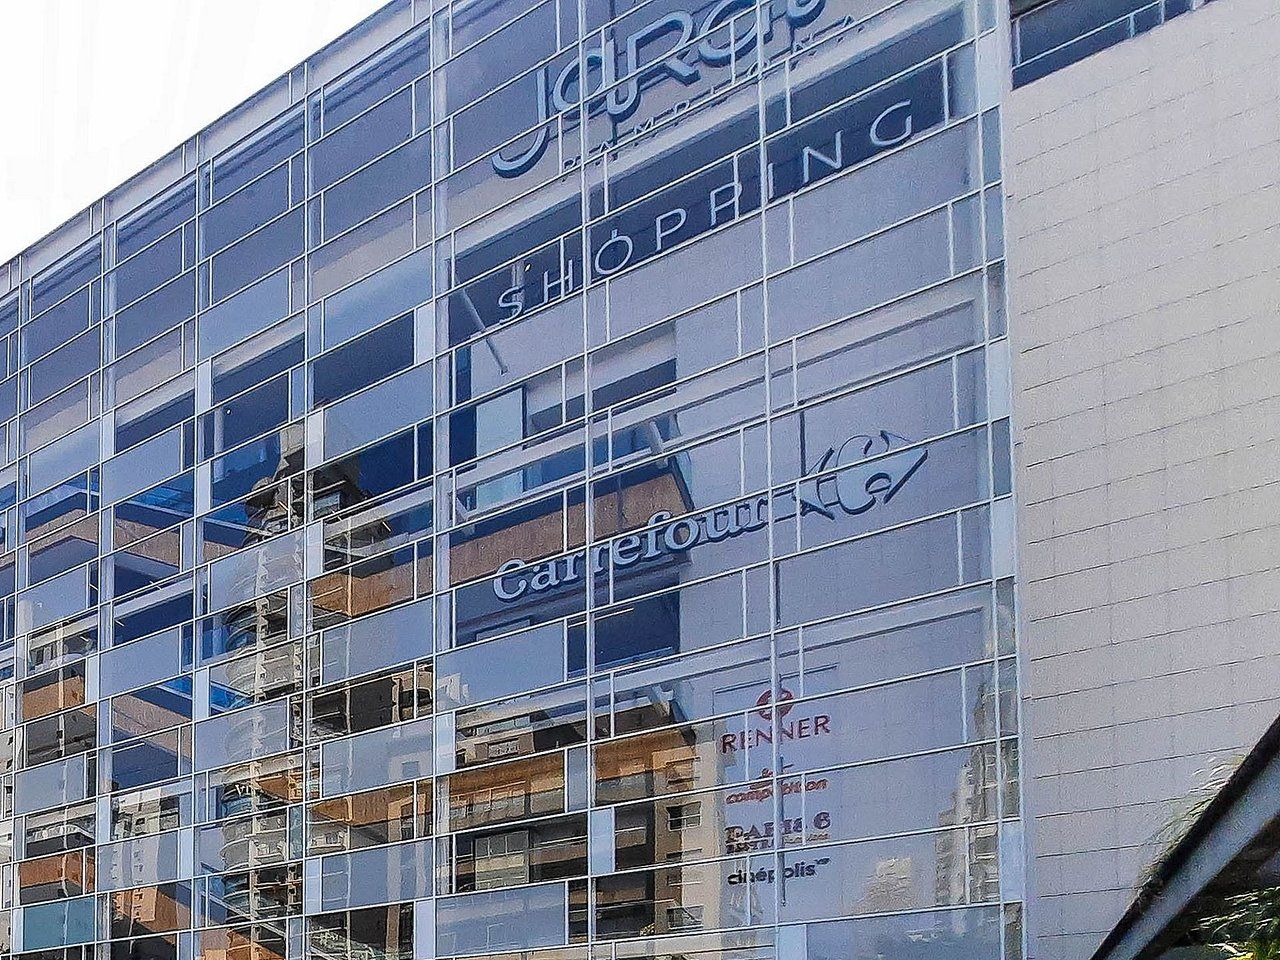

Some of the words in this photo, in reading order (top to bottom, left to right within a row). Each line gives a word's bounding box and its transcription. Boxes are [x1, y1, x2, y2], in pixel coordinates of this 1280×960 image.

[497, 98, 914, 324] SHOPPING
[492, 496, 771, 602] Carrefour
[720, 715, 831, 754] RENNER
